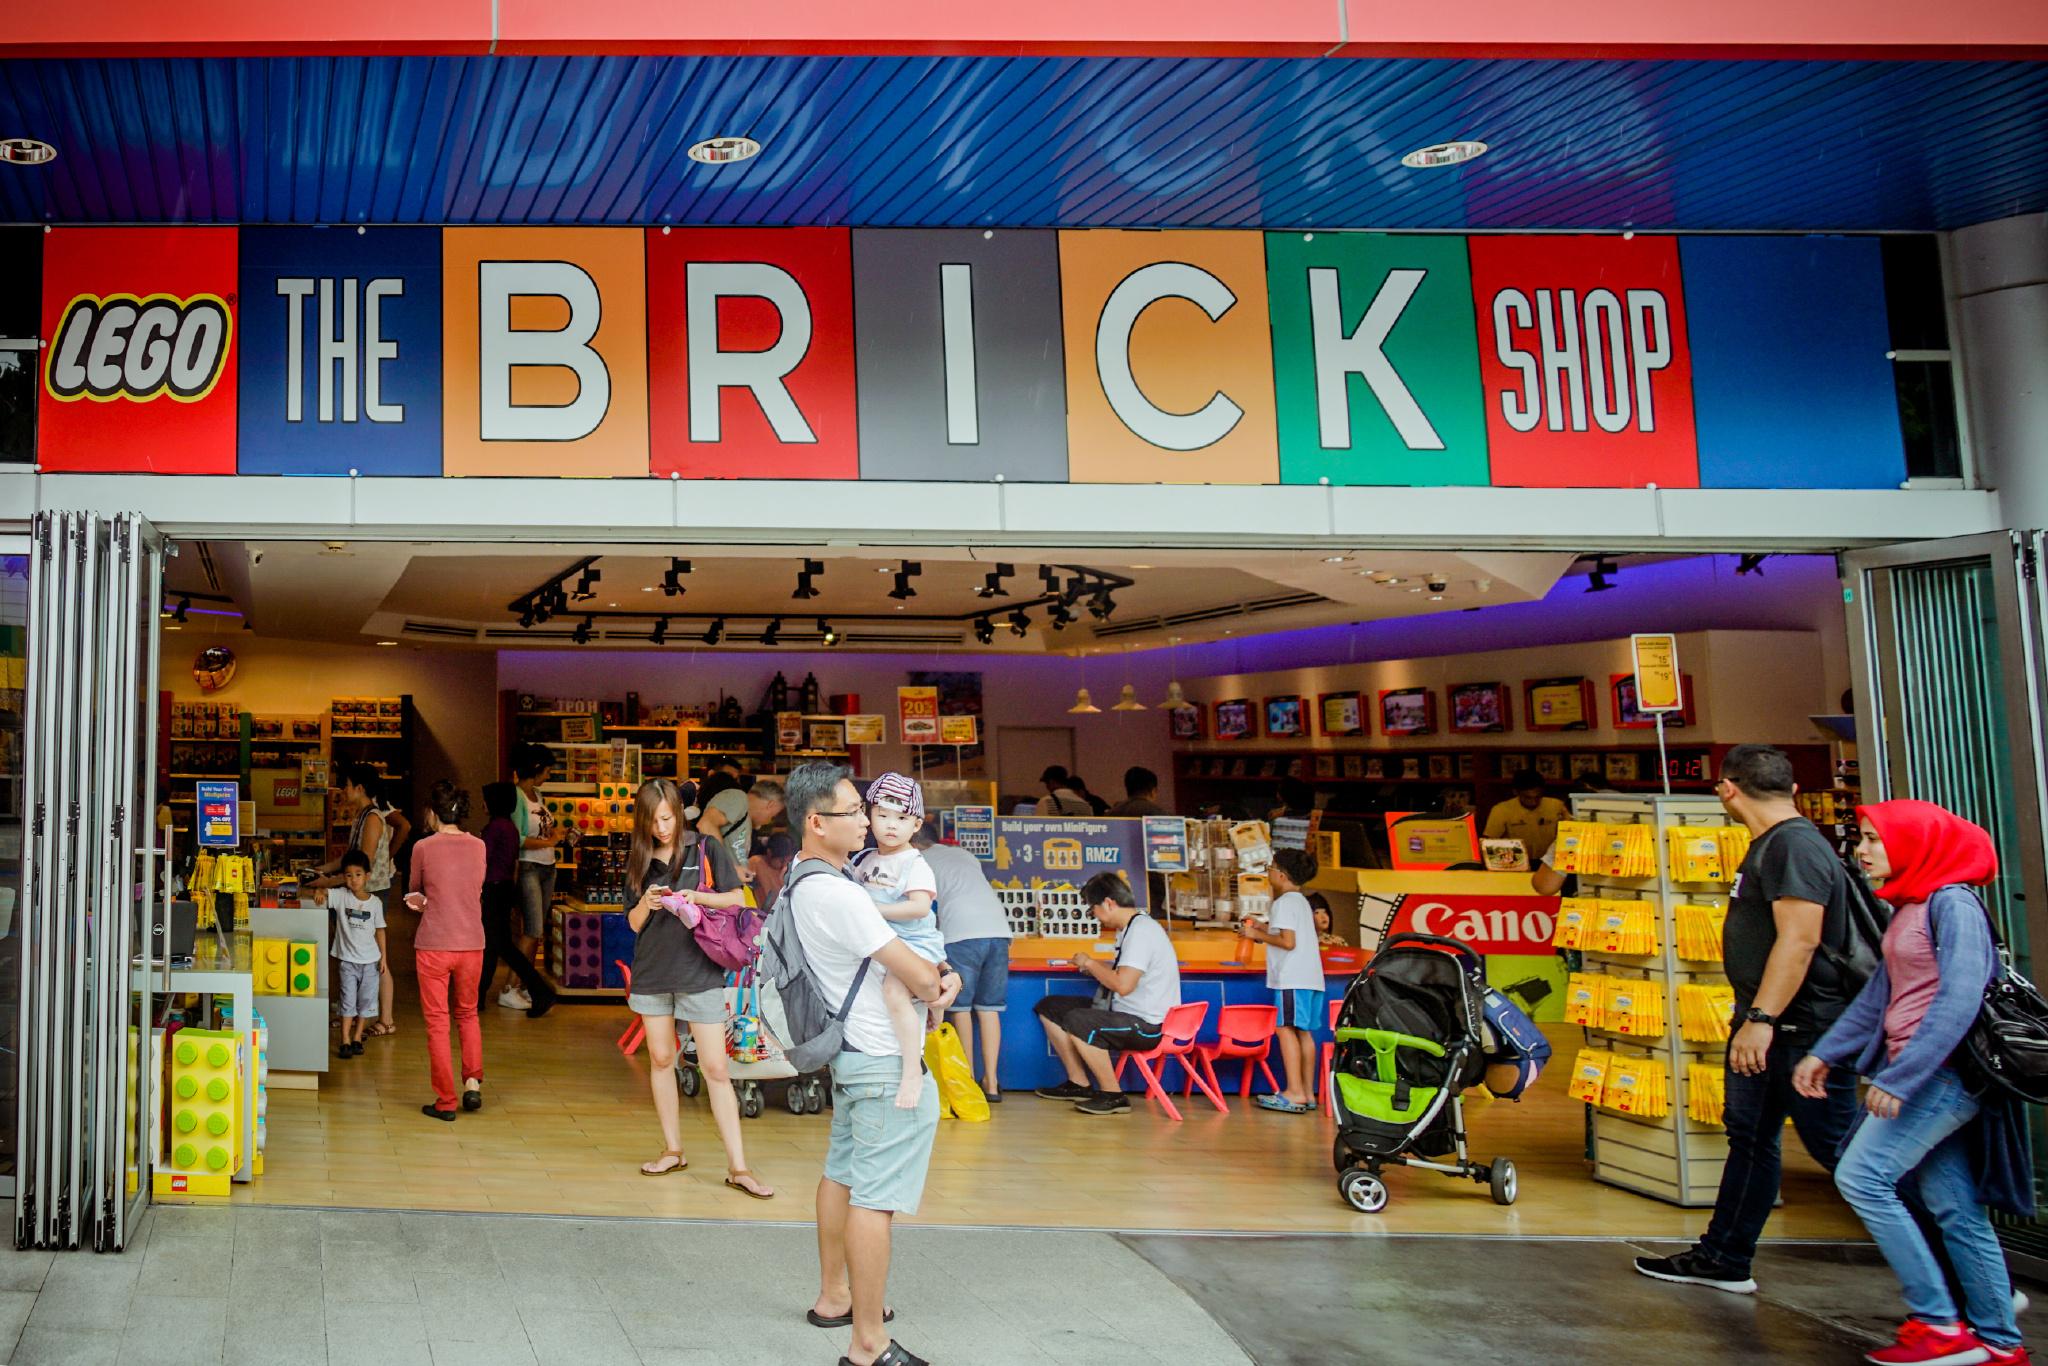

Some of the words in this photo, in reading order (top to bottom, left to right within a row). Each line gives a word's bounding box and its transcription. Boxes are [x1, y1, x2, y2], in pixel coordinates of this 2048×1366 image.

[48, 297, 230, 400] LEGO
[277, 276, 405, 424] THE
[479, 260, 1448, 452] BRICK
[1492, 287, 1673, 434] SHOP
[276, 787, 298, 798] LEGO
[1001, 821, 1023, 832] Build
[1023, 822, 1044, 835] your
[1044, 824, 1063, 832] own
[1023, 844, 1033, 863] 3
[1085, 846, 1120, 863] RM27
[1411, 902, 1559, 943] Cano
